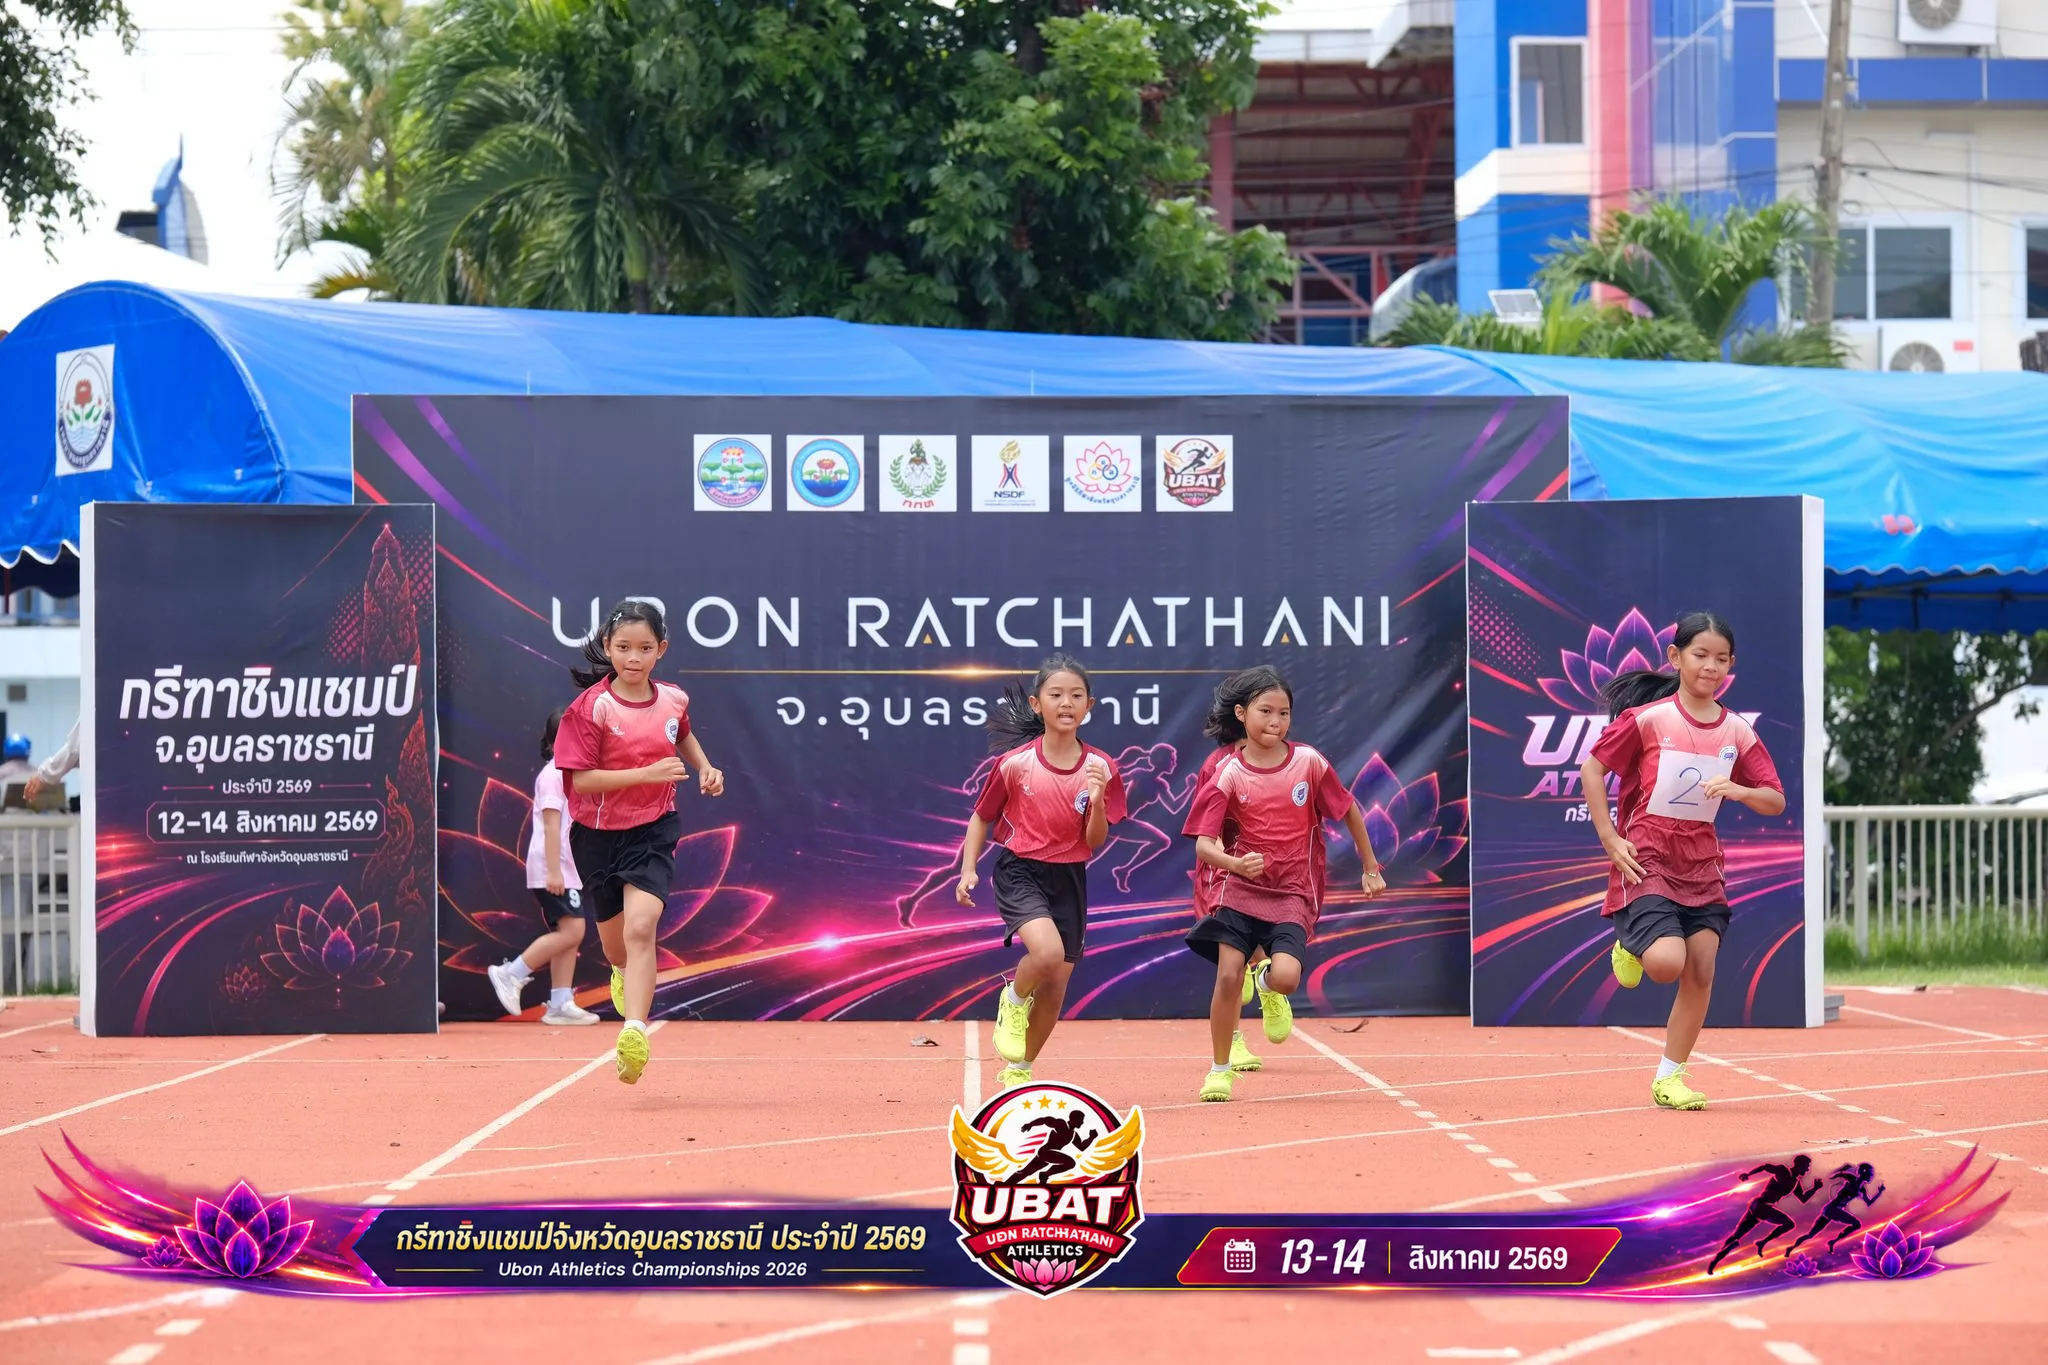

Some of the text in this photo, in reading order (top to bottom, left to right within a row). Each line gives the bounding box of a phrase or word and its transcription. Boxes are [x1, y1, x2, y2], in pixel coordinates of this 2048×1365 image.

[993, 490, 1025, 499] NSDF
[1168, 473, 1221, 488] UBAT
[552, 596, 1389, 648] UON RATCHATHANI
[119, 664, 418, 719] กรีฑาชิงแชมป์
[776, 684, 1160, 740] จ.อุบลรานี
[155, 723, 375, 774] จ.อุบลราชธานี
[222, 777, 312, 794] ประจำปี 2569
[1668, 766, 1702, 806] 2
[236, 810, 317, 833] สิงหาคม
[324, 810, 378, 832] 2569
[568, 888, 581, 908] 9
